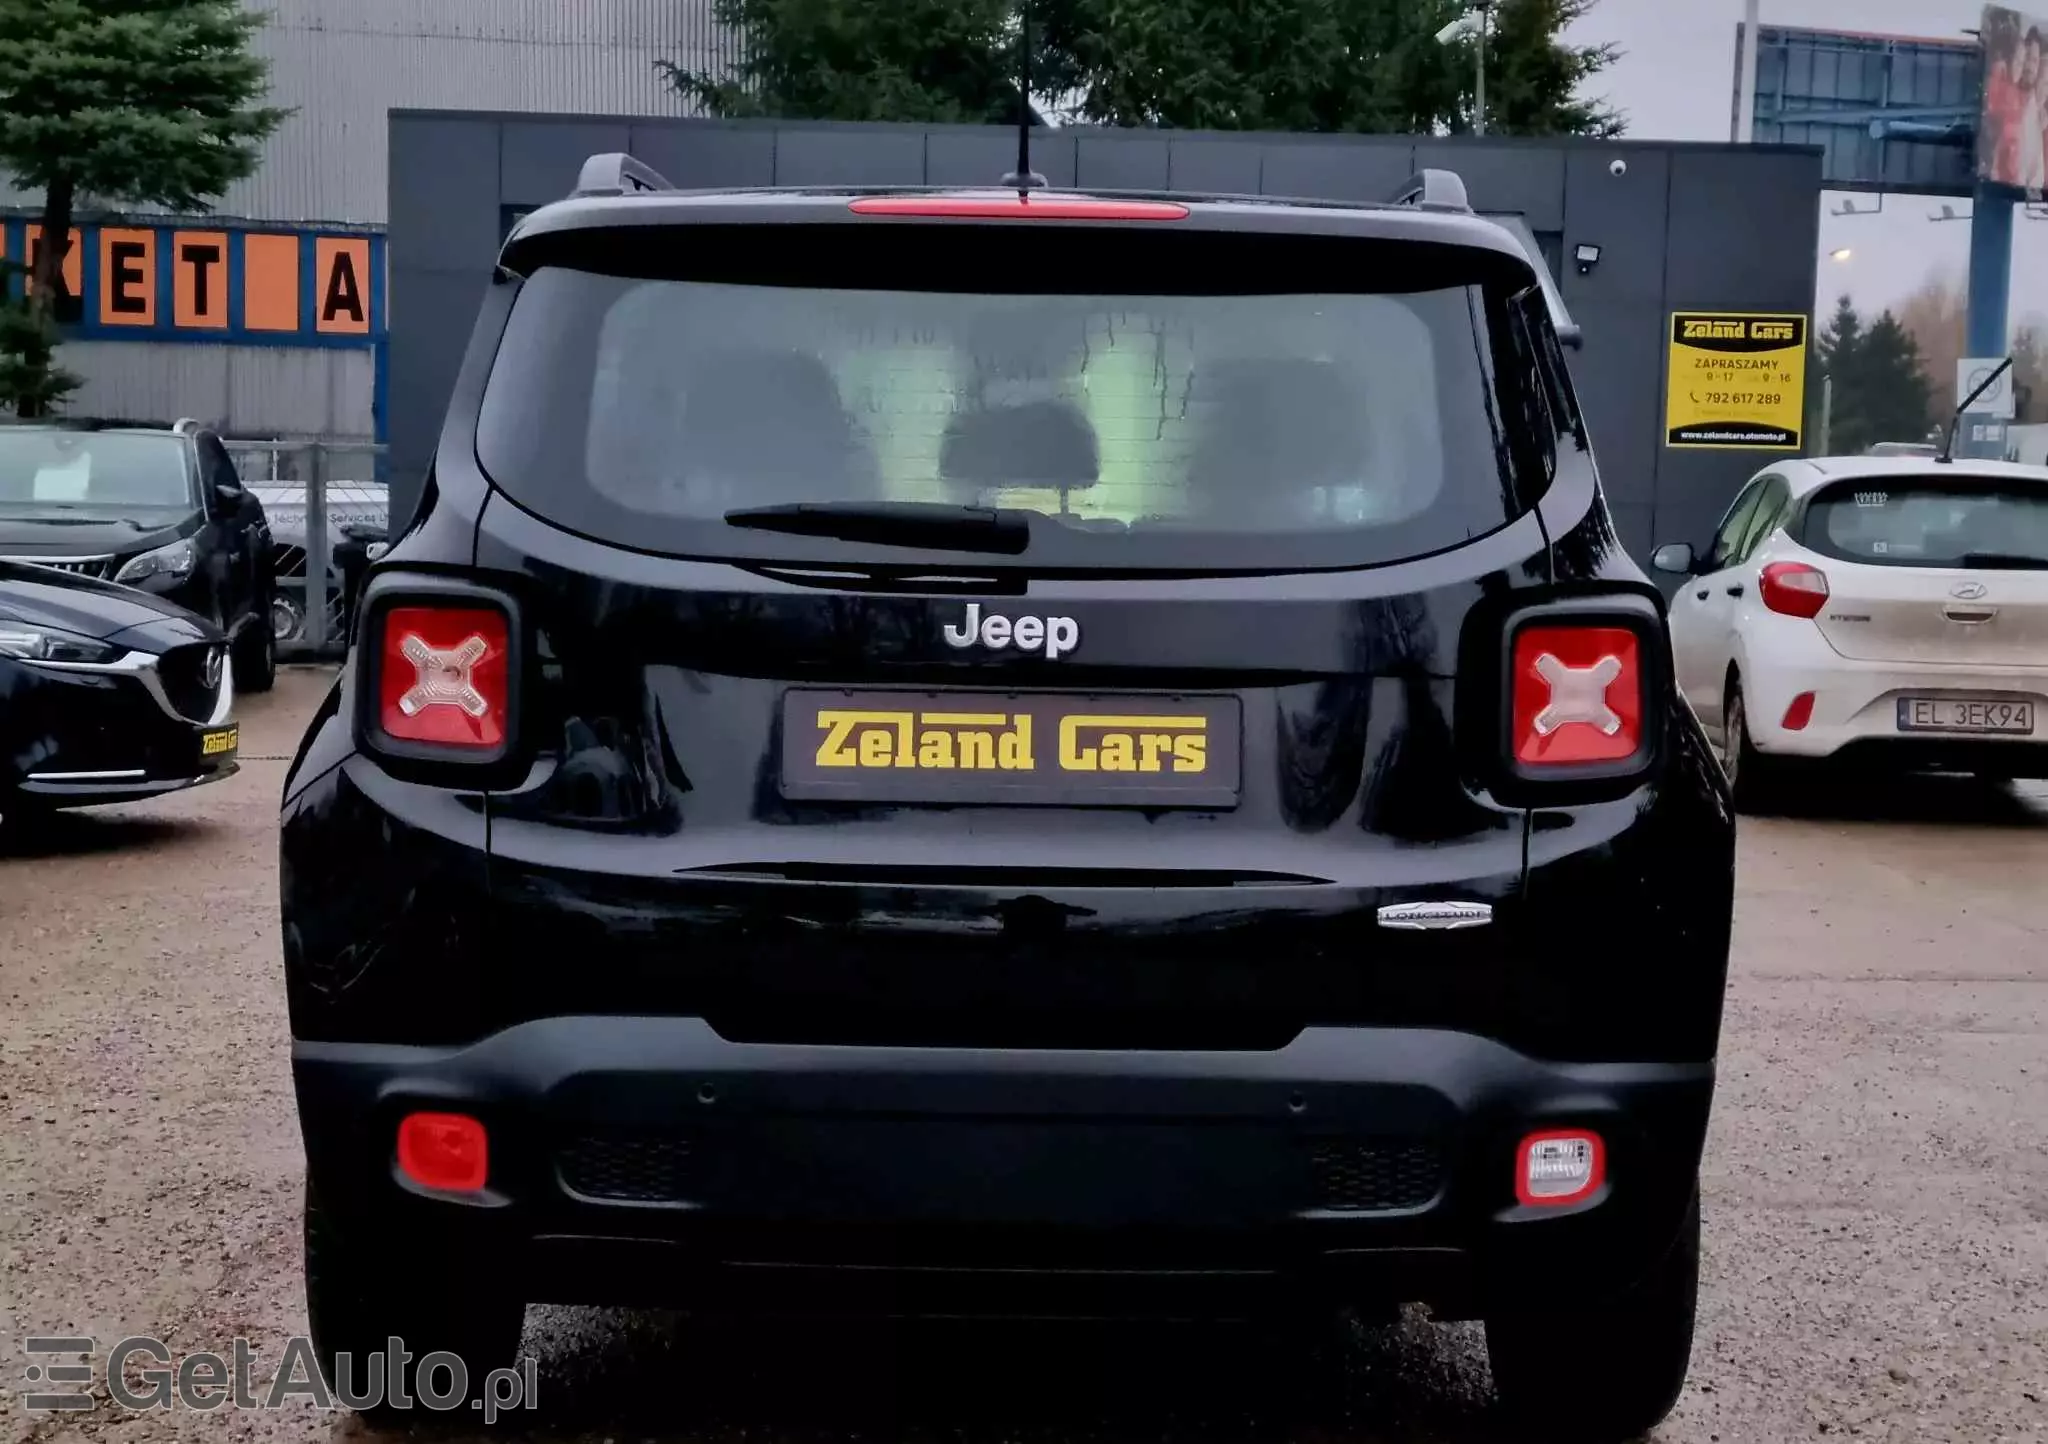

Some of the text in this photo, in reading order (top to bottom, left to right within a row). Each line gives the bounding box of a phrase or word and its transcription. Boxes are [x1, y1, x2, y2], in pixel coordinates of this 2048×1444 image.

[1683, 320, 1794, 339] Zeland Cars
[1695, 358, 1779, 369] ZAPRASZAMY
[1705, 392, 1729, 404] 792
[1733, 392, 1754, 404] 617
[943, 603, 1079, 658] Jeep
[1916, 702, 2026, 726] EL 3EK94
[816, 711, 1206, 772] Zeland Cars
